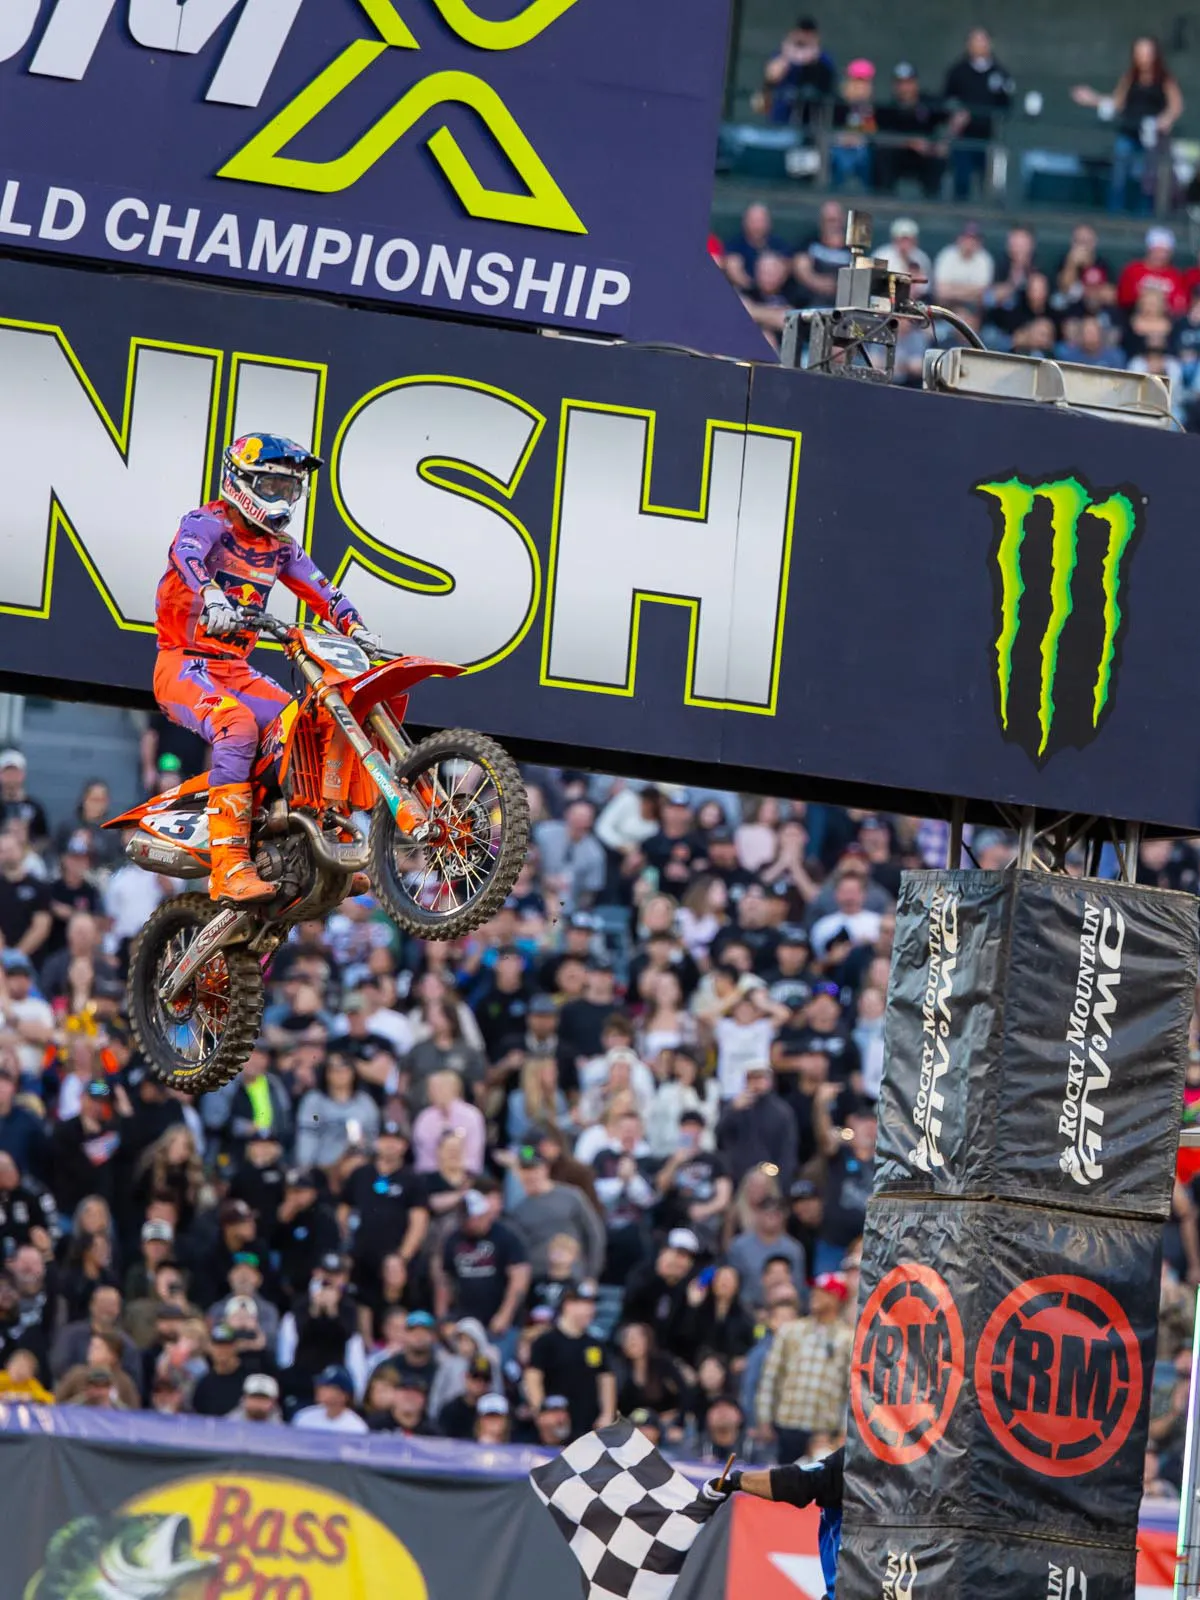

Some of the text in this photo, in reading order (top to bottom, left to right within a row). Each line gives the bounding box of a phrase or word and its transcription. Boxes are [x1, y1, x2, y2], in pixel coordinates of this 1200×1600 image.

[104, 197, 631, 321] CHAMPIONSHIP
[369, 767, 397, 801] MOTOREX
[912, 893, 944, 1129] ROCKY MOUNTAIN
[1058, 901, 1101, 1142] ROCKY MOUNTAIN
[196, 1486, 350, 1566] Bass
